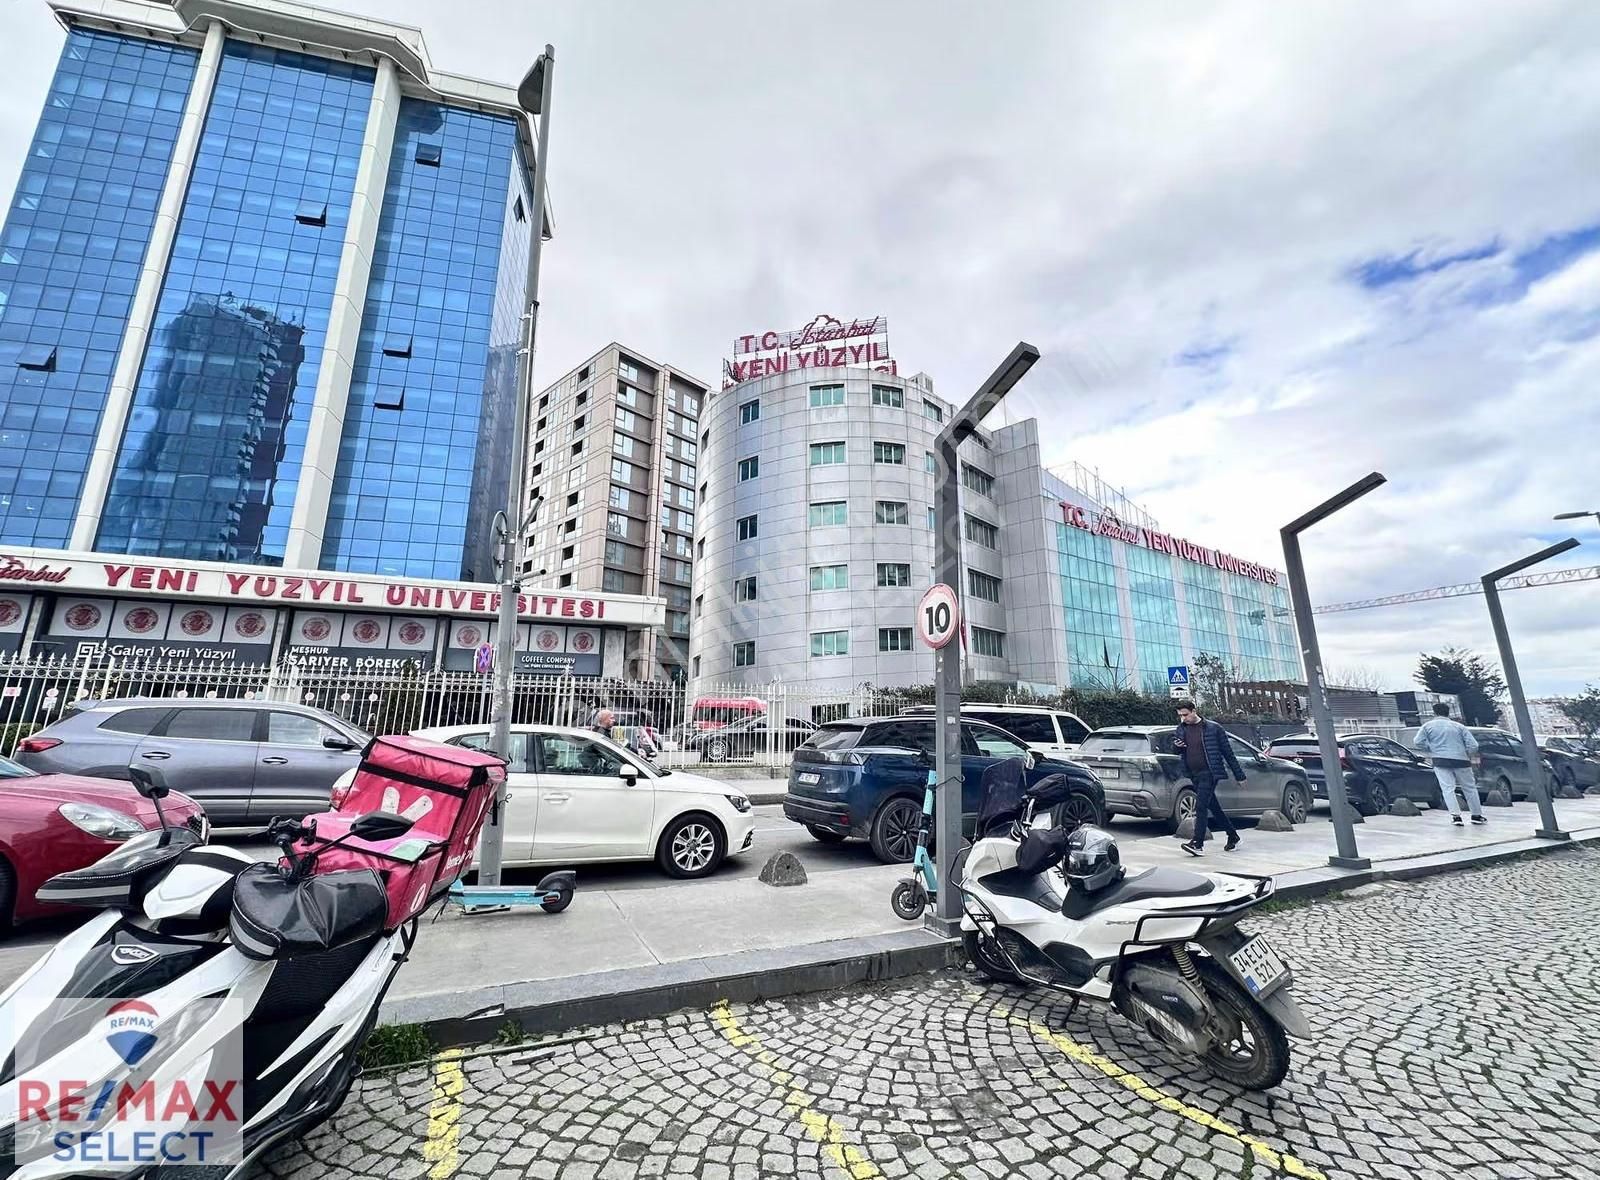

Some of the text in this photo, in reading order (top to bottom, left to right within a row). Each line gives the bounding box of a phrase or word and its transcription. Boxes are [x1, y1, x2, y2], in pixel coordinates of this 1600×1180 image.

[740, 331, 784, 354] T.C.
[796, 342, 889, 369] YÜZYIL
[1059, 501, 1090, 529] T.C.
[1173, 538, 1215, 567] YÜZYIL
[1214, 549, 1279, 585] ÜNİVERSİTESİ
[227, 574, 364, 603] YÜZYIL
[925, 602, 951, 635] 10
[112, 645, 236, 661] Galeri Yeni Yüzyıl
[289, 656, 349, 667] SARIYER
[291, 646, 329, 655] MEŞHUR
[521, 655, 576, 664] COFFEE COMPANY
[1254, 959, 1277, 983] 521
